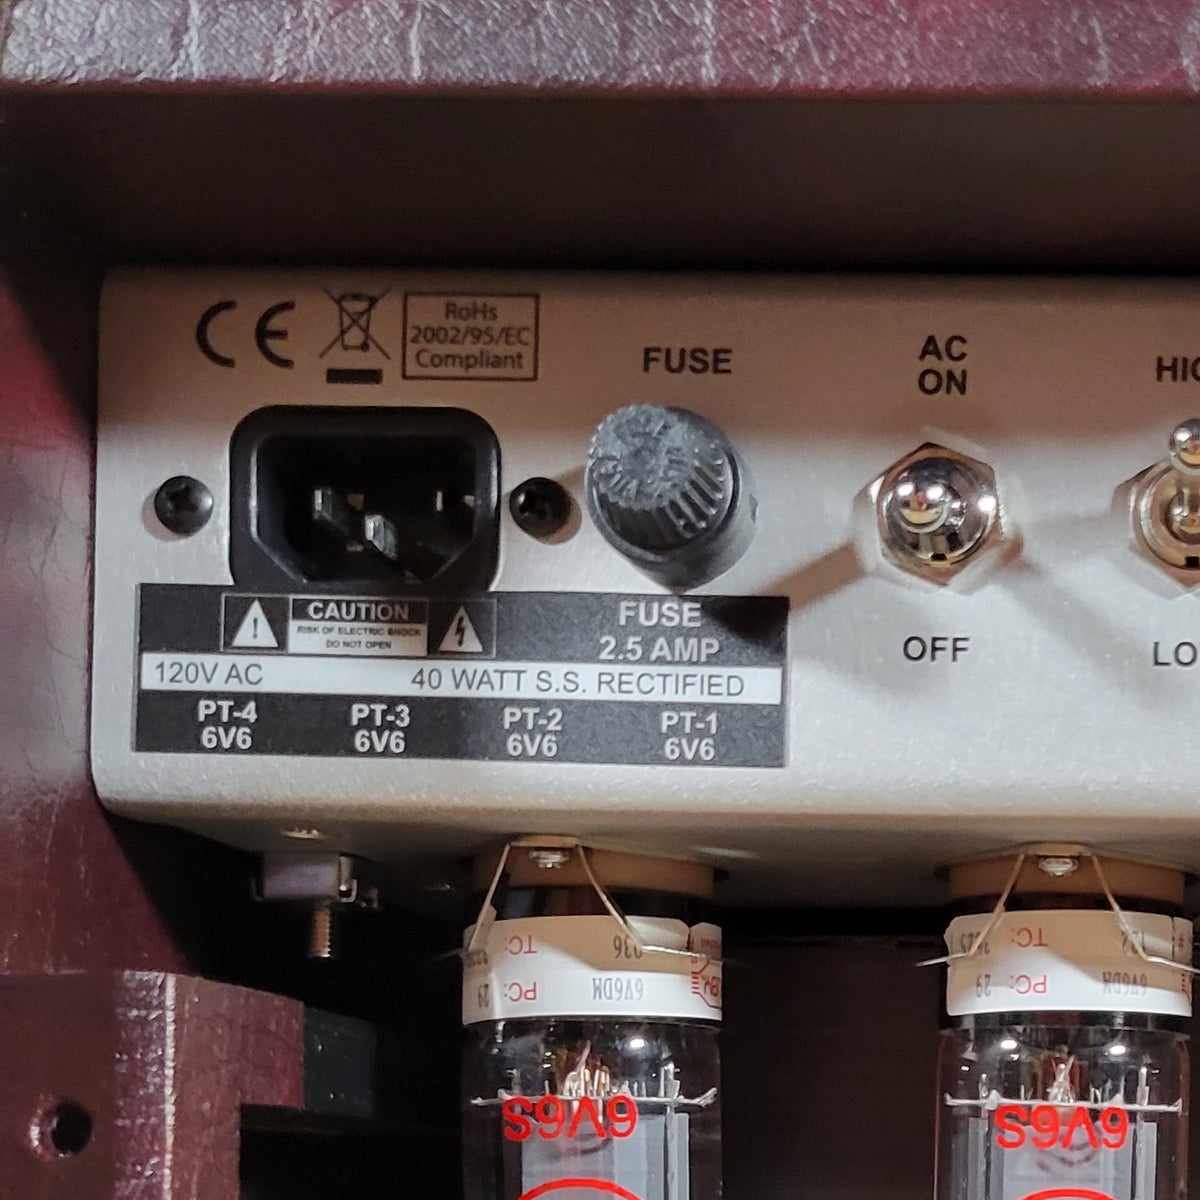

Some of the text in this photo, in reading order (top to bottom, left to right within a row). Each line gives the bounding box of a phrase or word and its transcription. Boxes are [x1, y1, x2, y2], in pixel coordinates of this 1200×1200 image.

[444, 302, 498, 321] RoHs
[410, 325, 532, 346] 2002/95/EC
[416, 349, 524, 370] Compliant
[918, 335, 967, 361] AC
[643, 347, 732, 374] FUSE
[918, 370, 967, 396] ON
[307, 601, 410, 621] CAUTION
[618, 601, 702, 627] FUSE
[297, 626, 319, 635] RISK
[322, 626, 334, 635] OF
[337, 627, 384, 635] ELECTRIC
[326, 640, 392, 649] DO NOT OPEN
[598, 635, 720, 663] 2.5 AMP
[902, 636, 970, 662] OFF
[155, 662, 263, 685] 120V AC
[411, 668, 745, 696] 40 WATT S.S. RECTIFIED
[198, 700, 258, 723] PT-4
[351, 703, 411, 727] PT-3
[503, 707, 563, 732] PT-2
[661, 711, 719, 734] PT-1
[201, 726, 252, 750] 6V6
[354, 730, 405, 753] 6V6
[506, 733, 558, 758] 6V6
[663, 738, 716, 761] 6V6
[976, 973, 992, 998] 29
[502, 1094, 638, 1141] 6V6S
[993, 1104, 1129, 1150] 6V6S
